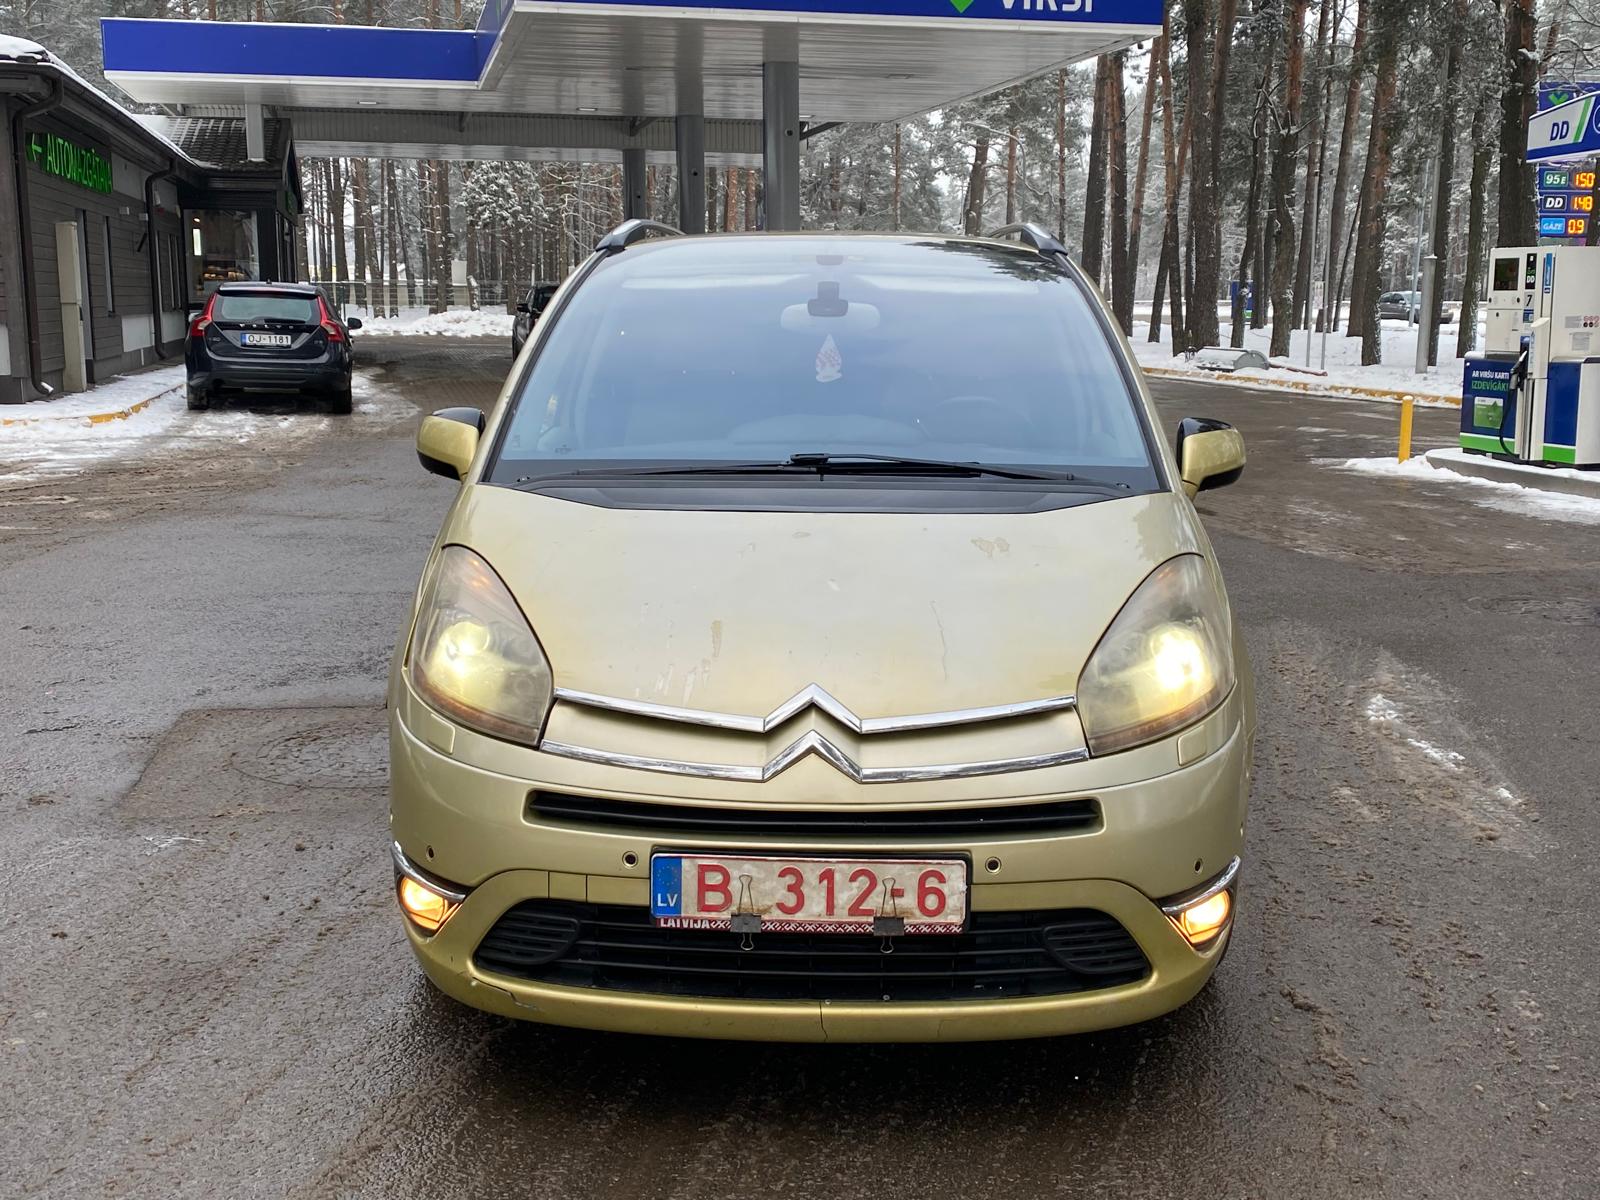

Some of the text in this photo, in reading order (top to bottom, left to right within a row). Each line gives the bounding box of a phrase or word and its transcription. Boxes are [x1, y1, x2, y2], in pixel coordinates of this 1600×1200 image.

[1550, 121, 1569, 141] DD
[1545, 174, 1567, 185] 95E
[1545, 197, 1564, 209] DD
[1526, 294, 1533, 307] 7
[248, 334, 290, 344] OJ-1181
[1472, 370, 1480, 378] AR
[697, 863, 733, 913] B
[657, 893, 678, 907] LV
[660, 917, 711, 929] LATVIJA
